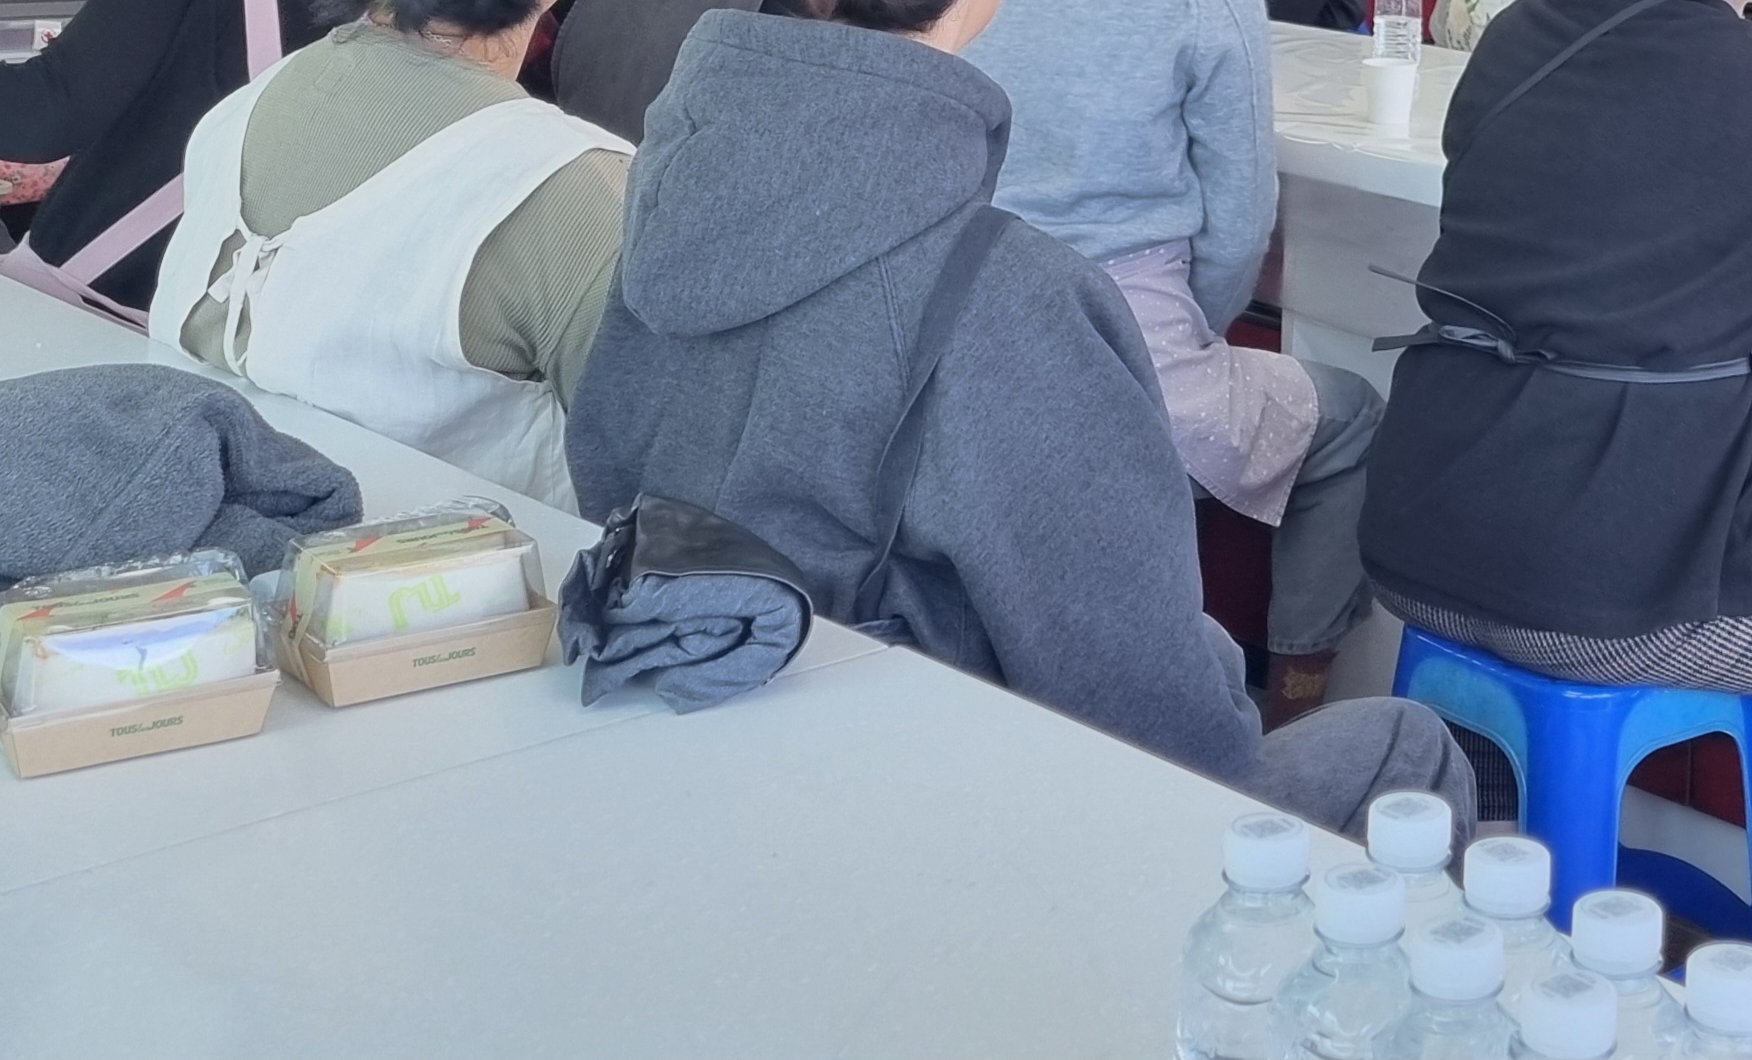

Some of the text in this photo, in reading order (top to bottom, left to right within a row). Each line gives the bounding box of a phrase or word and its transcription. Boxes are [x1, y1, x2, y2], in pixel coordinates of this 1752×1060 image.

[410, 654, 438, 668] TOUS
[446, 646, 477, 661] JOURS
[109, 723, 138, 738] TOUS
[149, 715, 184, 731] JOURS
